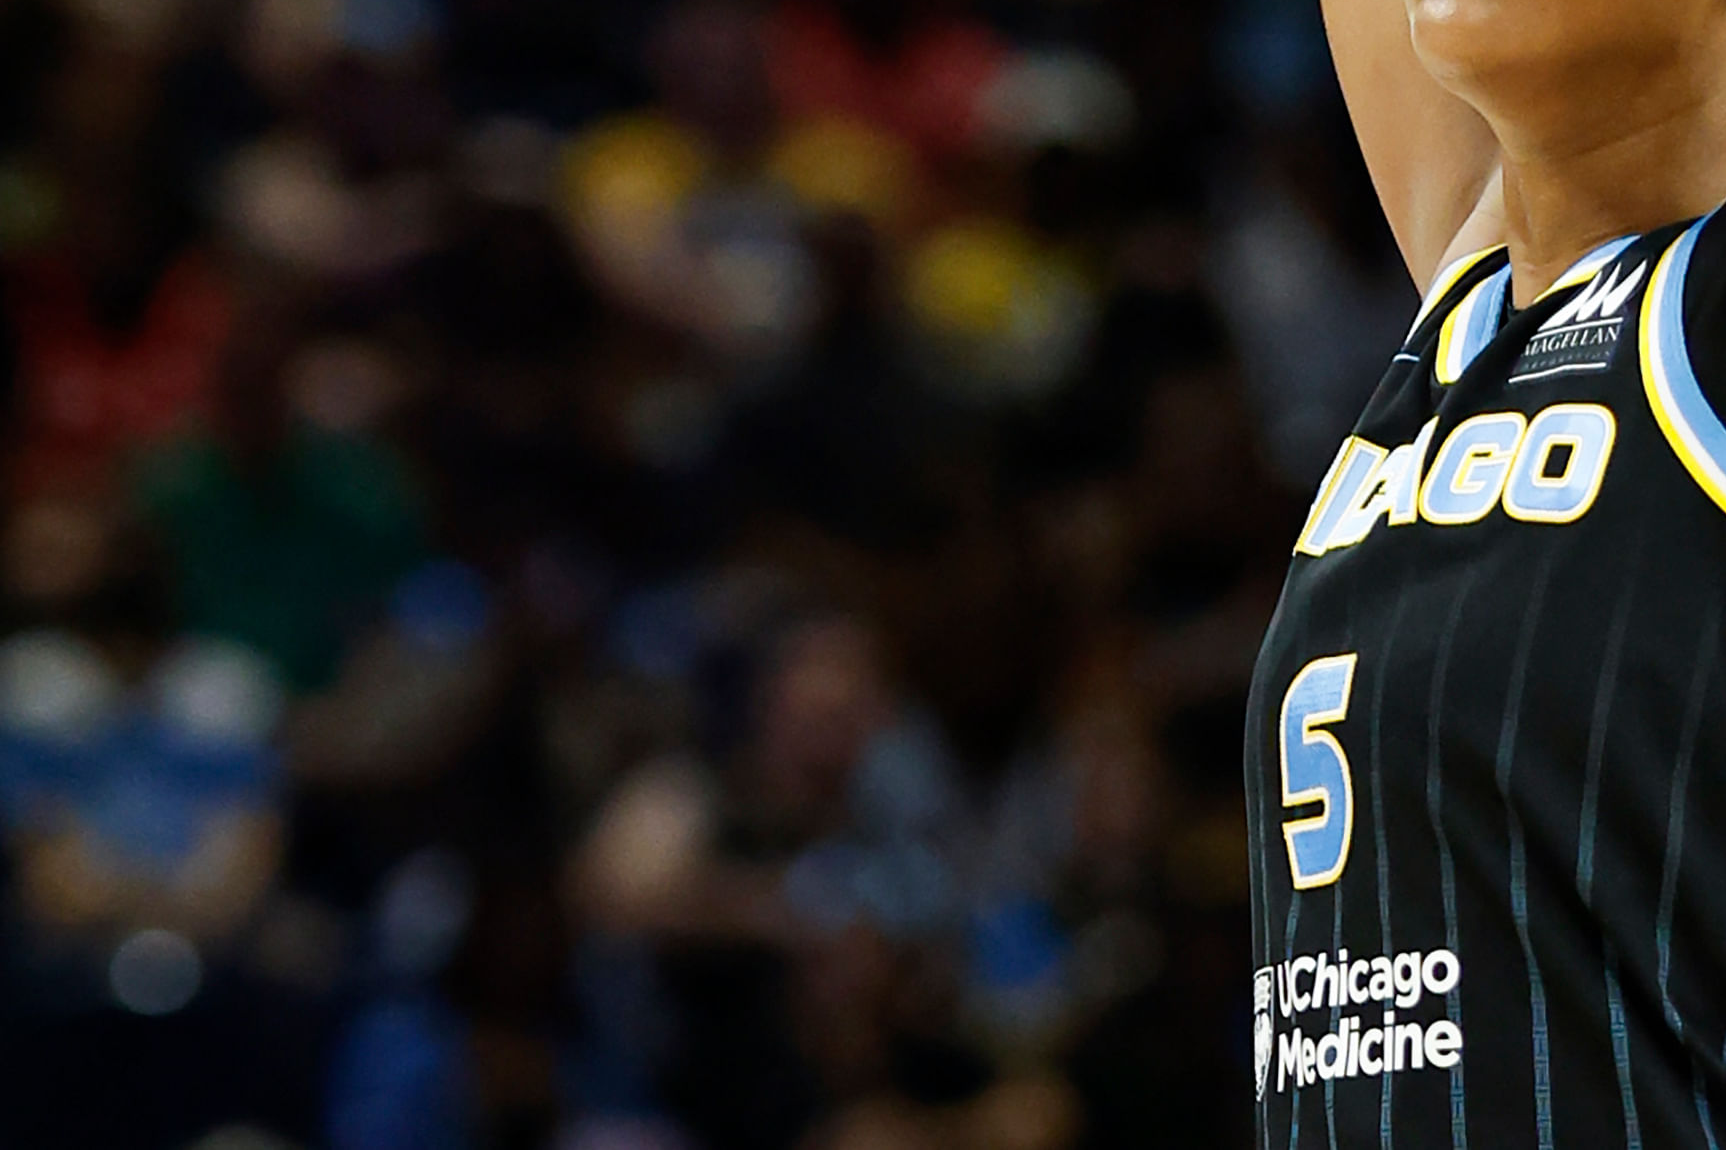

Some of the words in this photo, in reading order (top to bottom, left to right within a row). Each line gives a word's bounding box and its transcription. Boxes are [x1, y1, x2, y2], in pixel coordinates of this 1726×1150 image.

[1522, 325, 1621, 357] MAGELLAN
[1292, 403, 1616, 557] ICAGO
[1279, 652, 1358, 890] 5
[1277, 948, 1460, 1018] UChicago
[1277, 1010, 1463, 1093] Medicine
